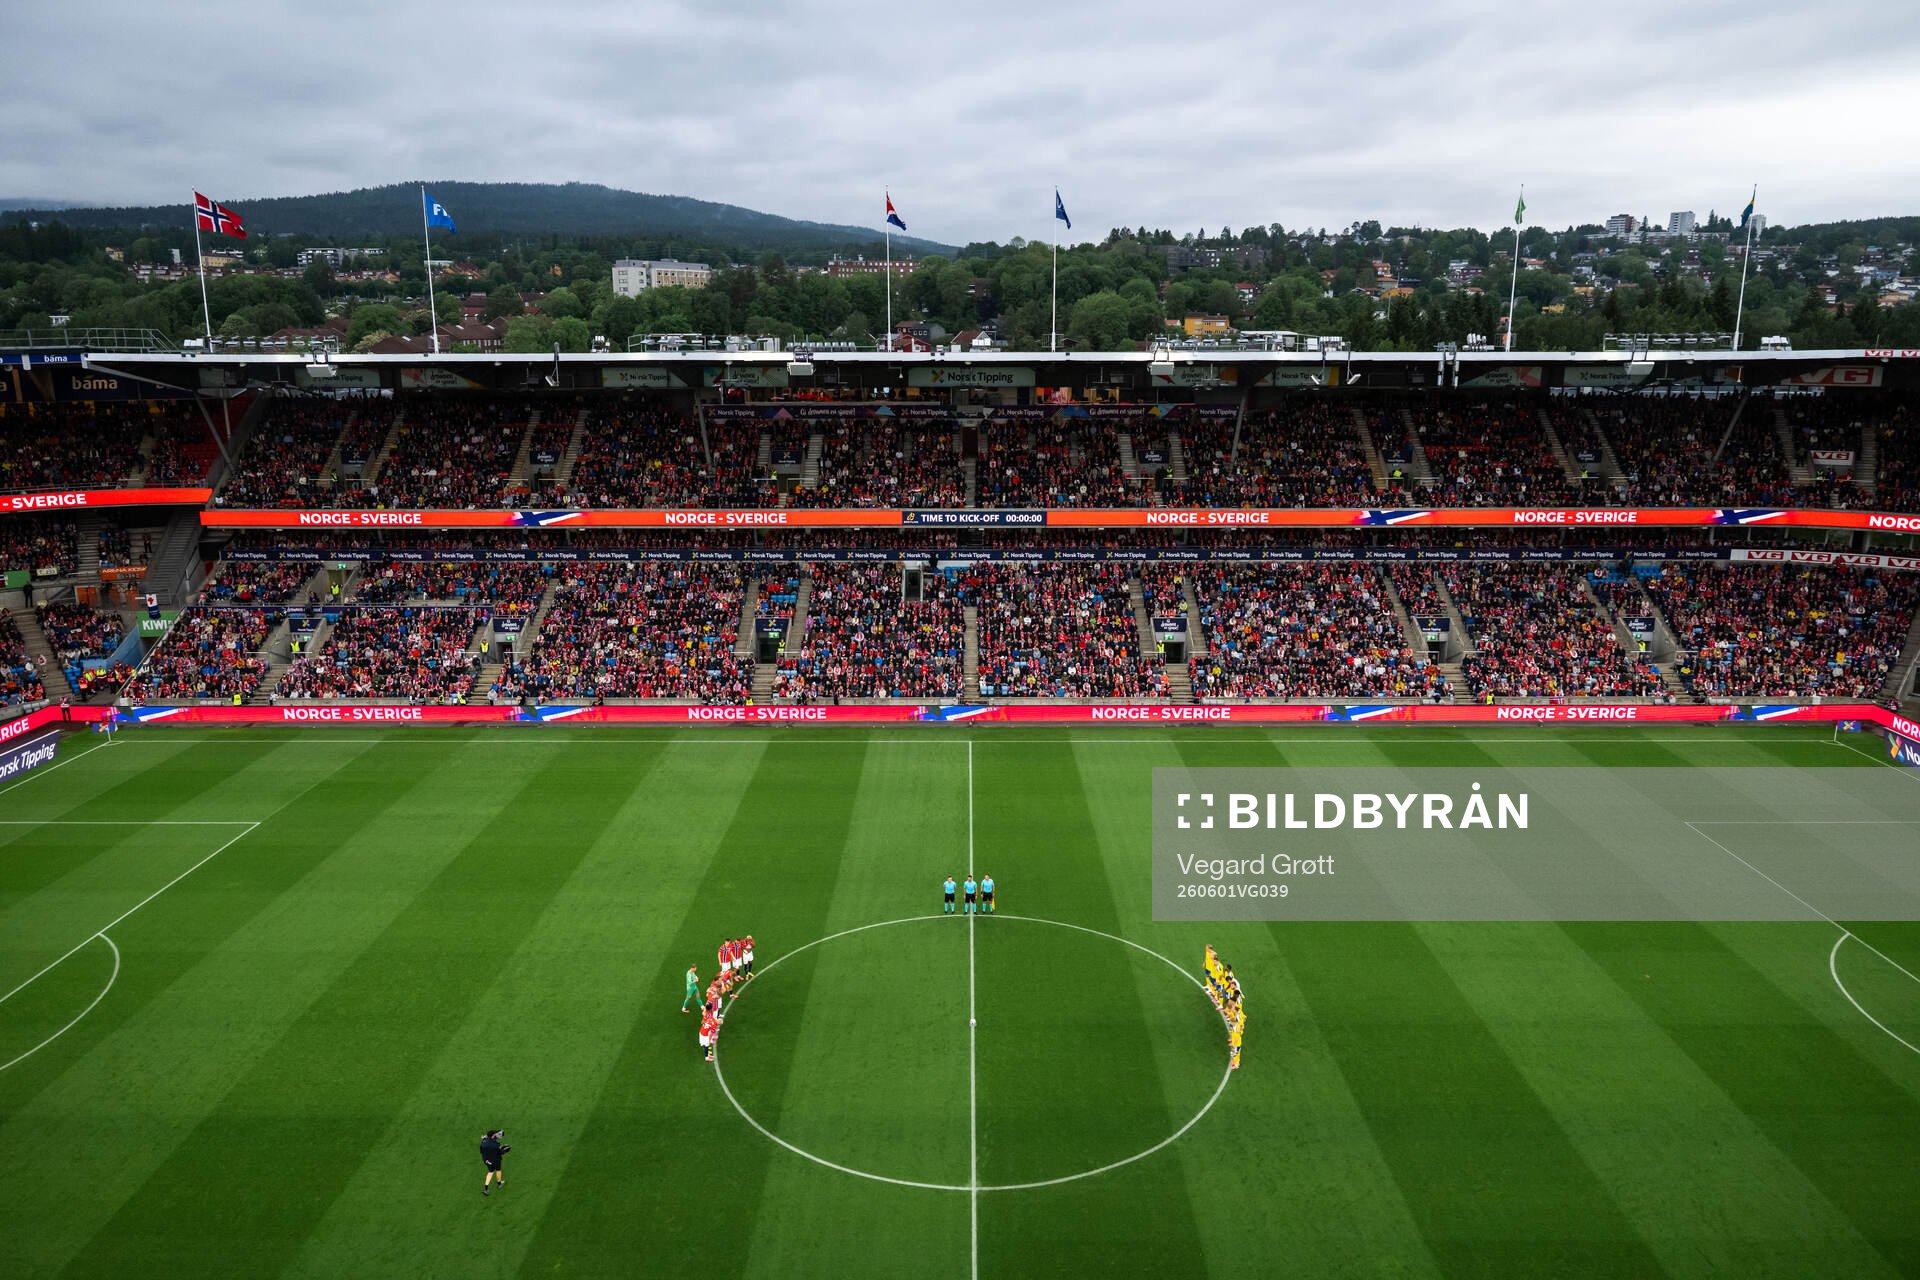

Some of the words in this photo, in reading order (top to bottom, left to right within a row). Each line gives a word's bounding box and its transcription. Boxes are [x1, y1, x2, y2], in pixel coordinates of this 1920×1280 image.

[977, 372, 1014, 384] Tipping
[1801, 367, 1869, 384] VG
[71, 376, 118, 391] bama
[1815, 451, 1850, 460] VG
[12, 493, 87, 509] SVERIGE
[300, 513, 350, 524] NORGE
[361, 513, 422, 524] SVERIGE
[665, 513, 716, 524] NORGE
[726, 513, 787, 524] SVERIGE
[920, 514, 943, 523] TIME
[945, 514, 958, 523] TO
[959, 514, 1000, 523] KICK-OFF
[1005, 514, 1043, 523] 00:00:00
[1146, 512, 1198, 523] NORGE
[1208, 512, 1269, 523] SVERIGE
[1514, 512, 1565, 523] NORGE
[1575, 512, 1637, 523] SVERIGE
[1869, 515, 1920, 530] NORG
[249, 552, 267, 560] Tipping
[301, 552, 319, 560] Tipping
[352, 552, 370, 560] Tipping
[405, 552, 423, 560] Tipping
[456, 552, 474, 560] Tipping
[508, 552, 526, 560] Tipping
[560, 552, 578, 560] Tipping
[611, 552, 629, 560] Tipping
[663, 552, 681, 560] Tipping
[715, 552, 733, 560] Tipping
[766, 552, 784, 560] Tipping
[818, 552, 836, 560] Tipping
[870, 552, 888, 560] Tipping
[973, 552, 991, 560] Tipping
[1025, 552, 1043, 560] Tipping
[1077, 552, 1095, 560] Tipping
[1129, 552, 1147, 560] Tipping
[1181, 552, 1199, 560] Tipping
[1233, 552, 1251, 560] Tipping
[1285, 552, 1303, 560] Tipping
[1337, 552, 1355, 560] Tipping
[1388, 552, 1406, 560] Tipping
[1440, 552, 1458, 560] Tipping
[1492, 552, 1510, 560] Tipping
[1544, 552, 1562, 560] Tipping
[1596, 552, 1614, 560] Tipping
[1648, 552, 1666, 560] Tipping
[1750, 551, 1783, 560] VG
[1793, 552, 1830, 562] VG
[1841, 555, 1880, 564] VG
[142, 619, 168, 631] KIWI
[283, 707, 341, 720] NORGE
[353, 707, 423, 720] SVERIGE
[688, 707, 746, 720] NORGE
[757, 707, 827, 720] SVERIGE
[1092, 707, 1150, 720] NORGE
[1161, 707, 1231, 720] SVERIGE
[1497, 707, 1555, 720] NORGE
[1567, 707, 1637, 720] SVERIGE
[0, 718, 29, 742] RIGE
[1893, 716, 1920, 739] NOR
[22, 743, 56, 769] Tipping
